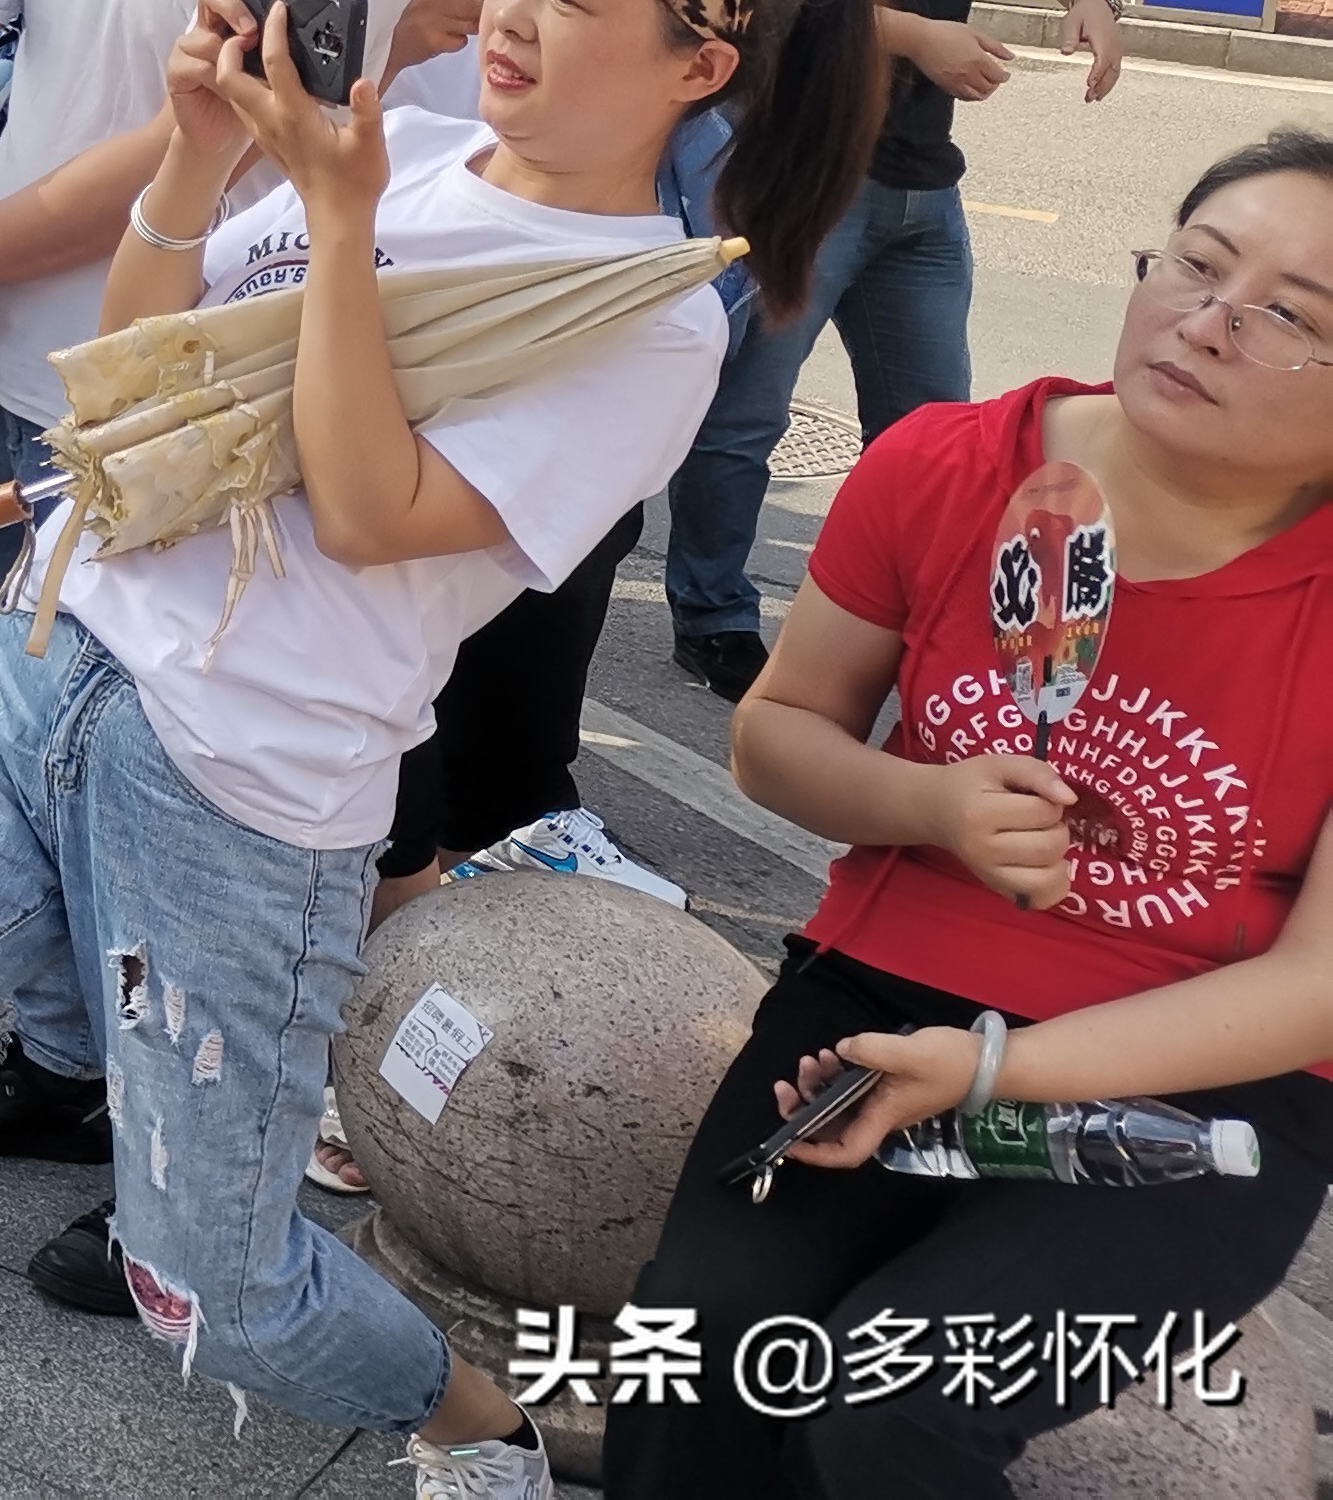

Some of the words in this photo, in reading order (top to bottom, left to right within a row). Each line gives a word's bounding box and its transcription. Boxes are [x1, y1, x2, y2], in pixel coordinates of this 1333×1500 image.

[421, 1000, 476, 1054] 招聘暑假工
